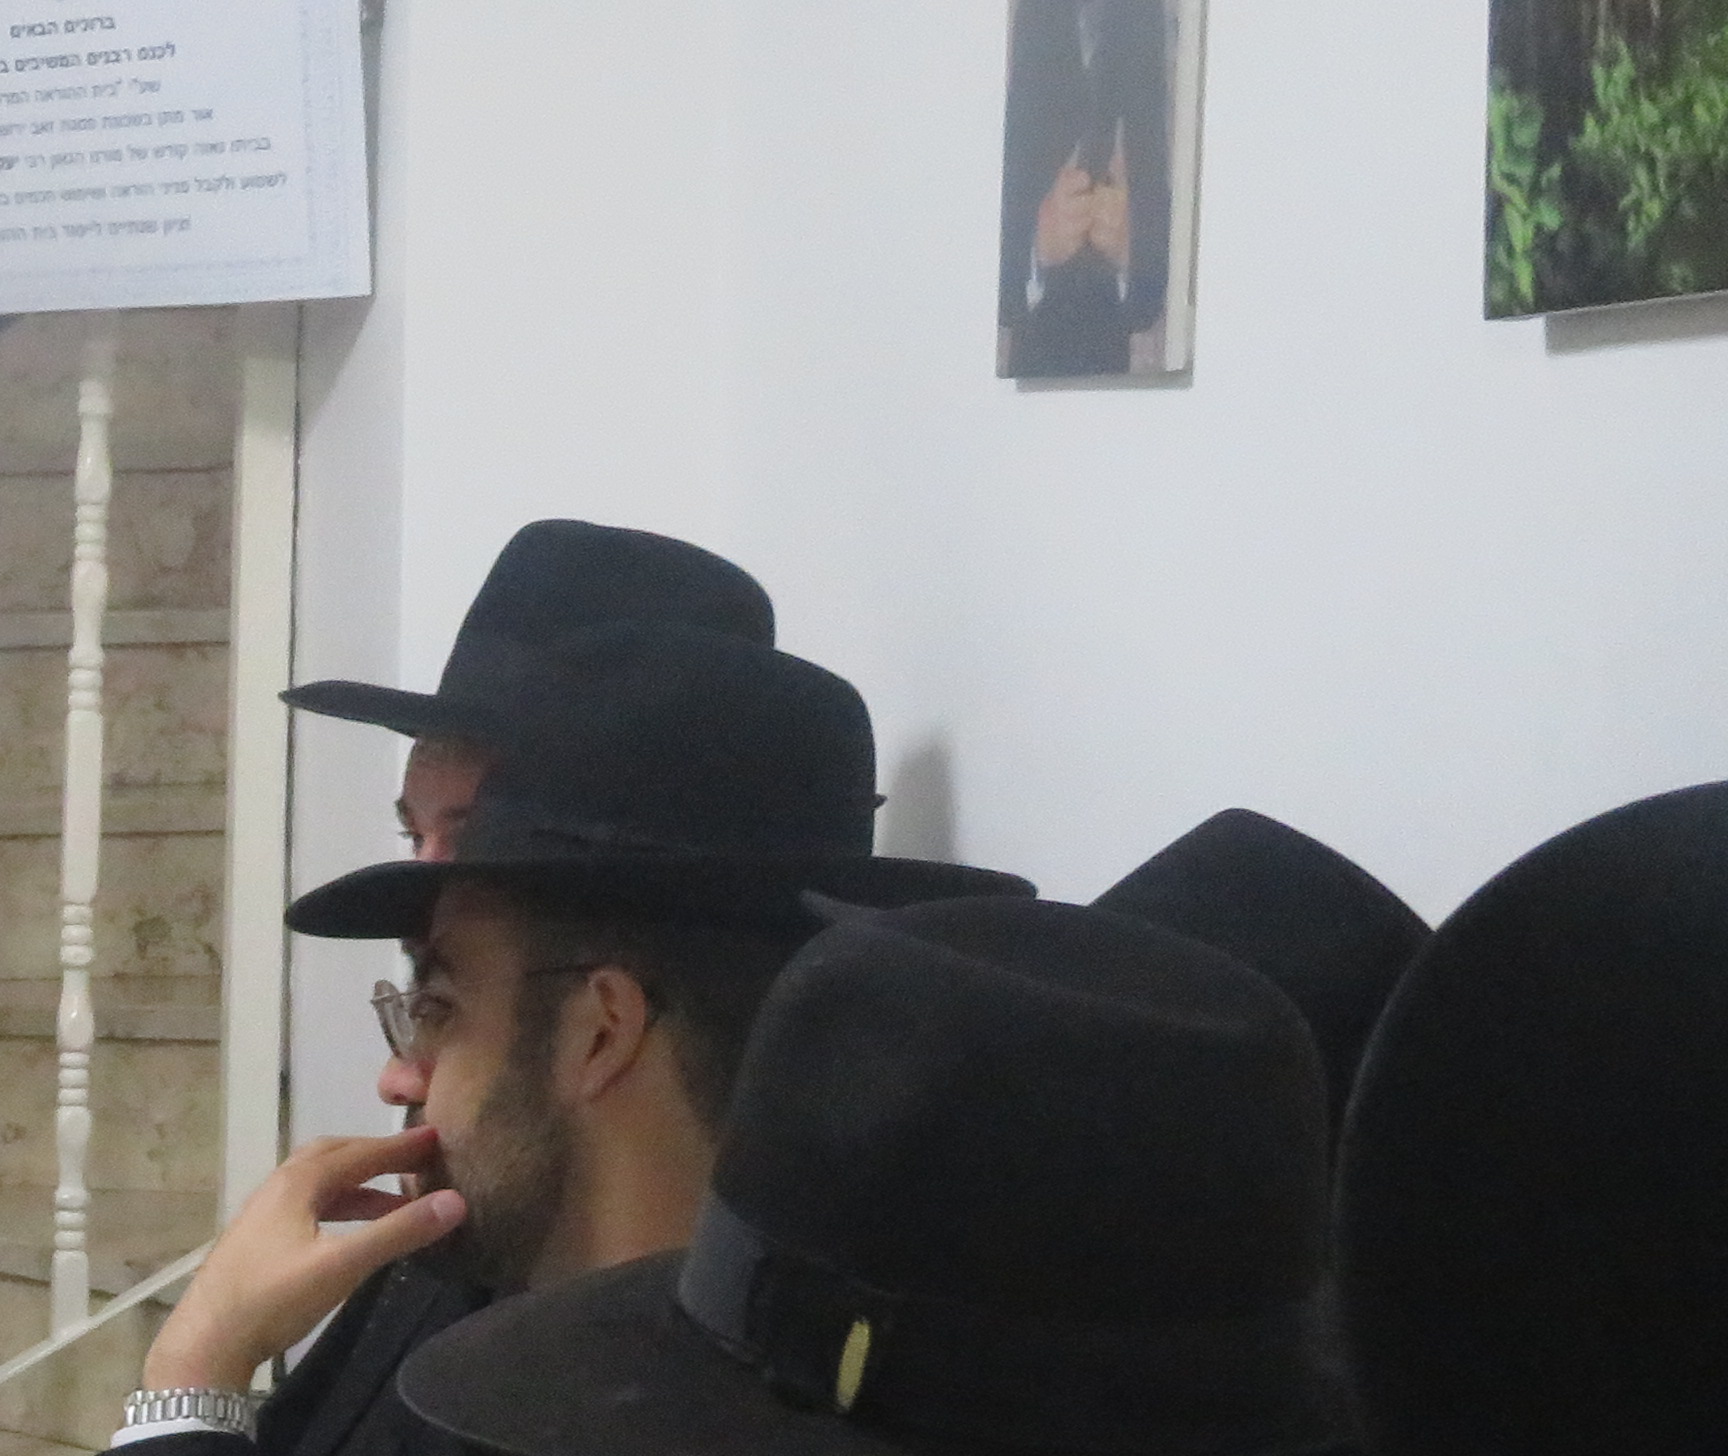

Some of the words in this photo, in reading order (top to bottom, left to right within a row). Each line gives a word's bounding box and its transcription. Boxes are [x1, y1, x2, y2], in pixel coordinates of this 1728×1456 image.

[9, 22, 58, 38] הבאים
[64, 17, 115, 33] ברוכים
[87, 49, 131, 65] רבנים
[137, 42, 175, 60] לכנס
[14, 54, 80, 71] המשיבים
[35, 87, 86, 101] ההוראה
[31, 120, 53, 134] זאב
[59, 116, 96, 132] פסגת
[102, 112, 152, 128] בשכונת
[126, 144, 148, 160] של
[153, 143, 188, 160] קודש
[240, 173, 287, 189] לשמוע
